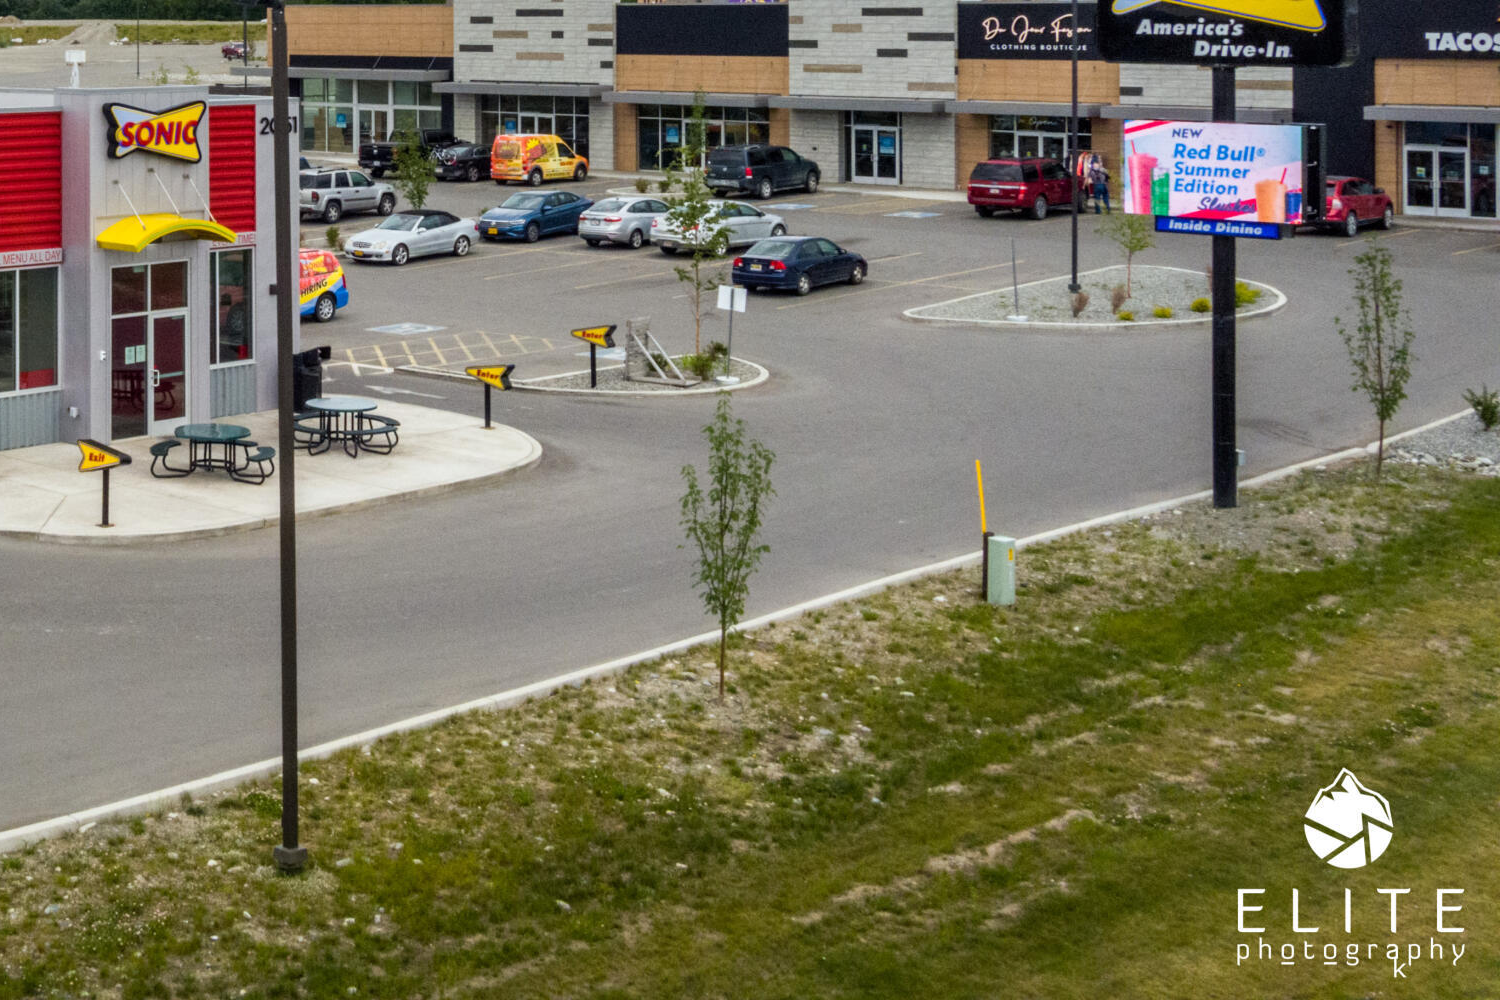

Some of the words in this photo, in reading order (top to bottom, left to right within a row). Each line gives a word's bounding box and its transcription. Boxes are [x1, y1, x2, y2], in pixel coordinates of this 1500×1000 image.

[1136, 17, 1244, 36] America's
[990, 43, 1037, 51] CLOTHING
[1424, 32, 1500, 52] TACOS
[118, 120, 198, 147] SONIC
[1171, 128, 1203, 139] NEW
[1173, 143, 1211, 160] Red
[1173, 162, 1250, 179] Summer
[1173, 178, 1238, 196] Edition
[1168, 219, 1211, 232] Inside
[1215, 222, 1263, 235] Dining
[2, 252, 28, 265] MENU
[29, 252, 44, 262] ALL
[45, 250, 60, 261] DAY
[300, 278, 328, 297] HIRING
[581, 330, 604, 340] Enter
[476, 369, 499, 380] Enter
[88, 452, 105, 463] Exit
